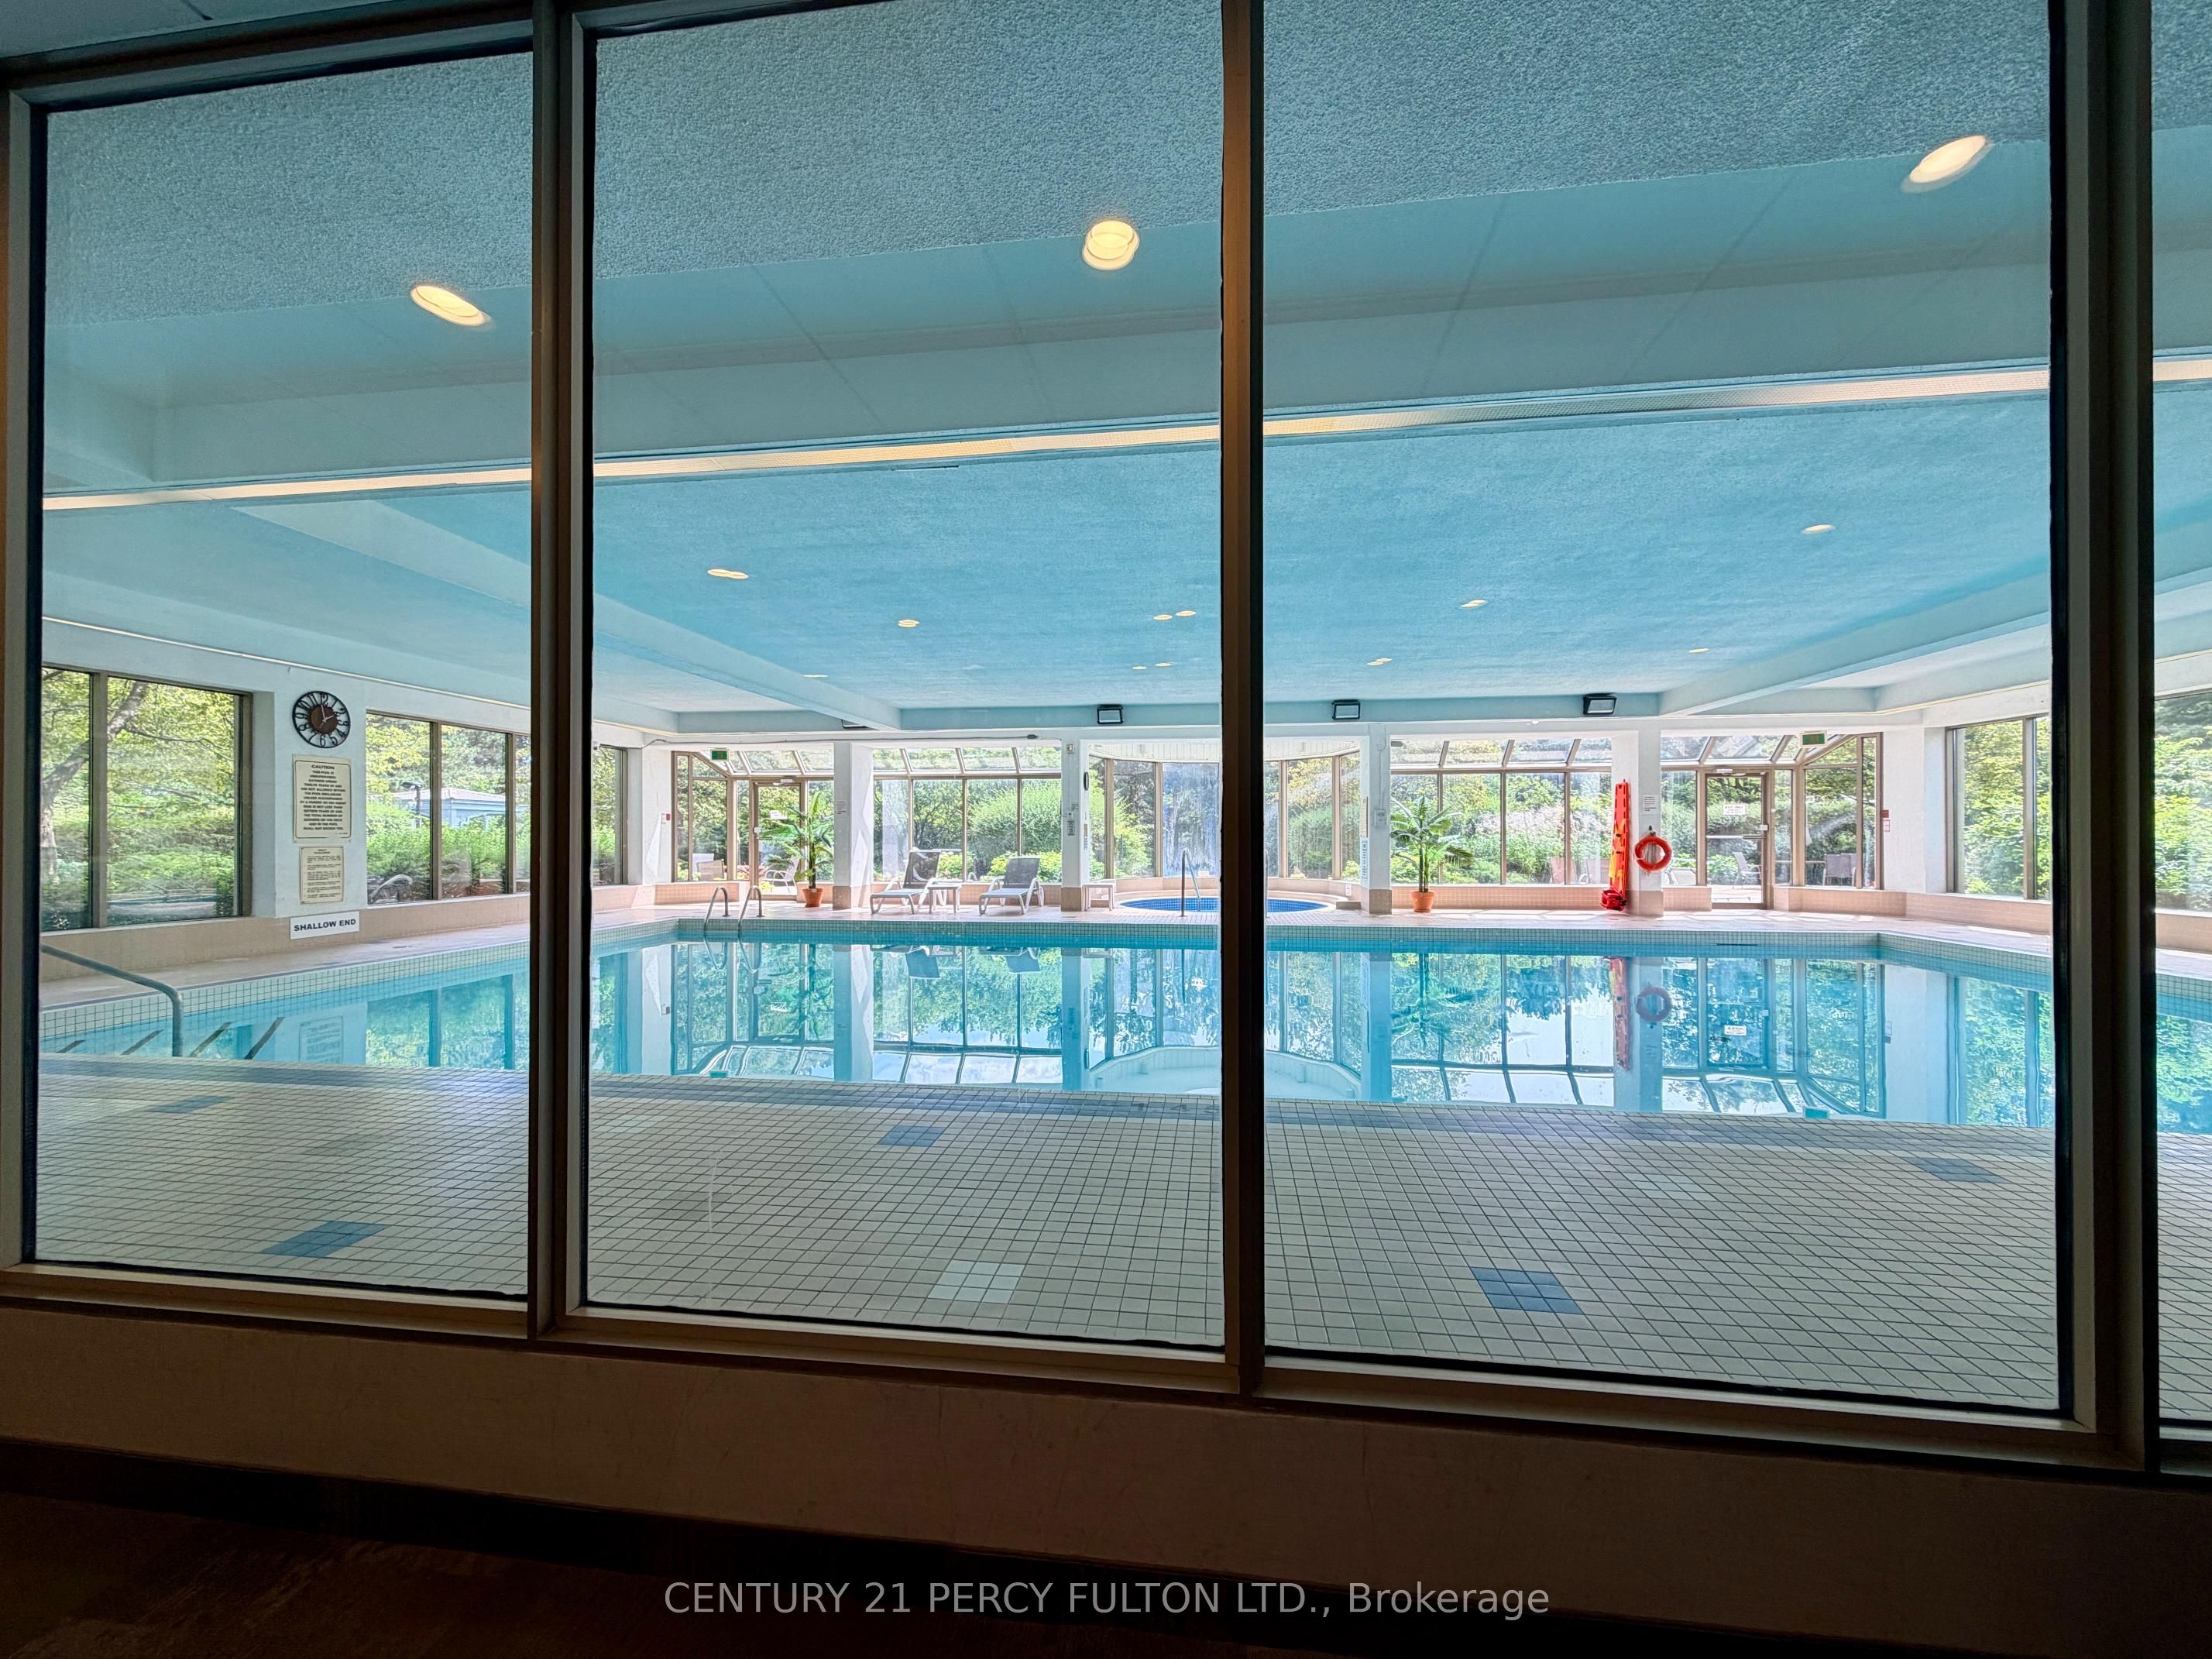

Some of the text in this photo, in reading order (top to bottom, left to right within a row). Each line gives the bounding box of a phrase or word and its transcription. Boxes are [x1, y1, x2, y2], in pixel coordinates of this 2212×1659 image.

[320, 693, 328, 707] 12
[334, 707, 347, 717] 2
[298, 723, 311, 731] 8
[335, 727, 347, 737] 4
[308, 730, 319, 743] 7
[320, 734, 326, 748] 6
[328, 733, 338, 746] 5
[294, 920, 337, 932] SHALLOW
